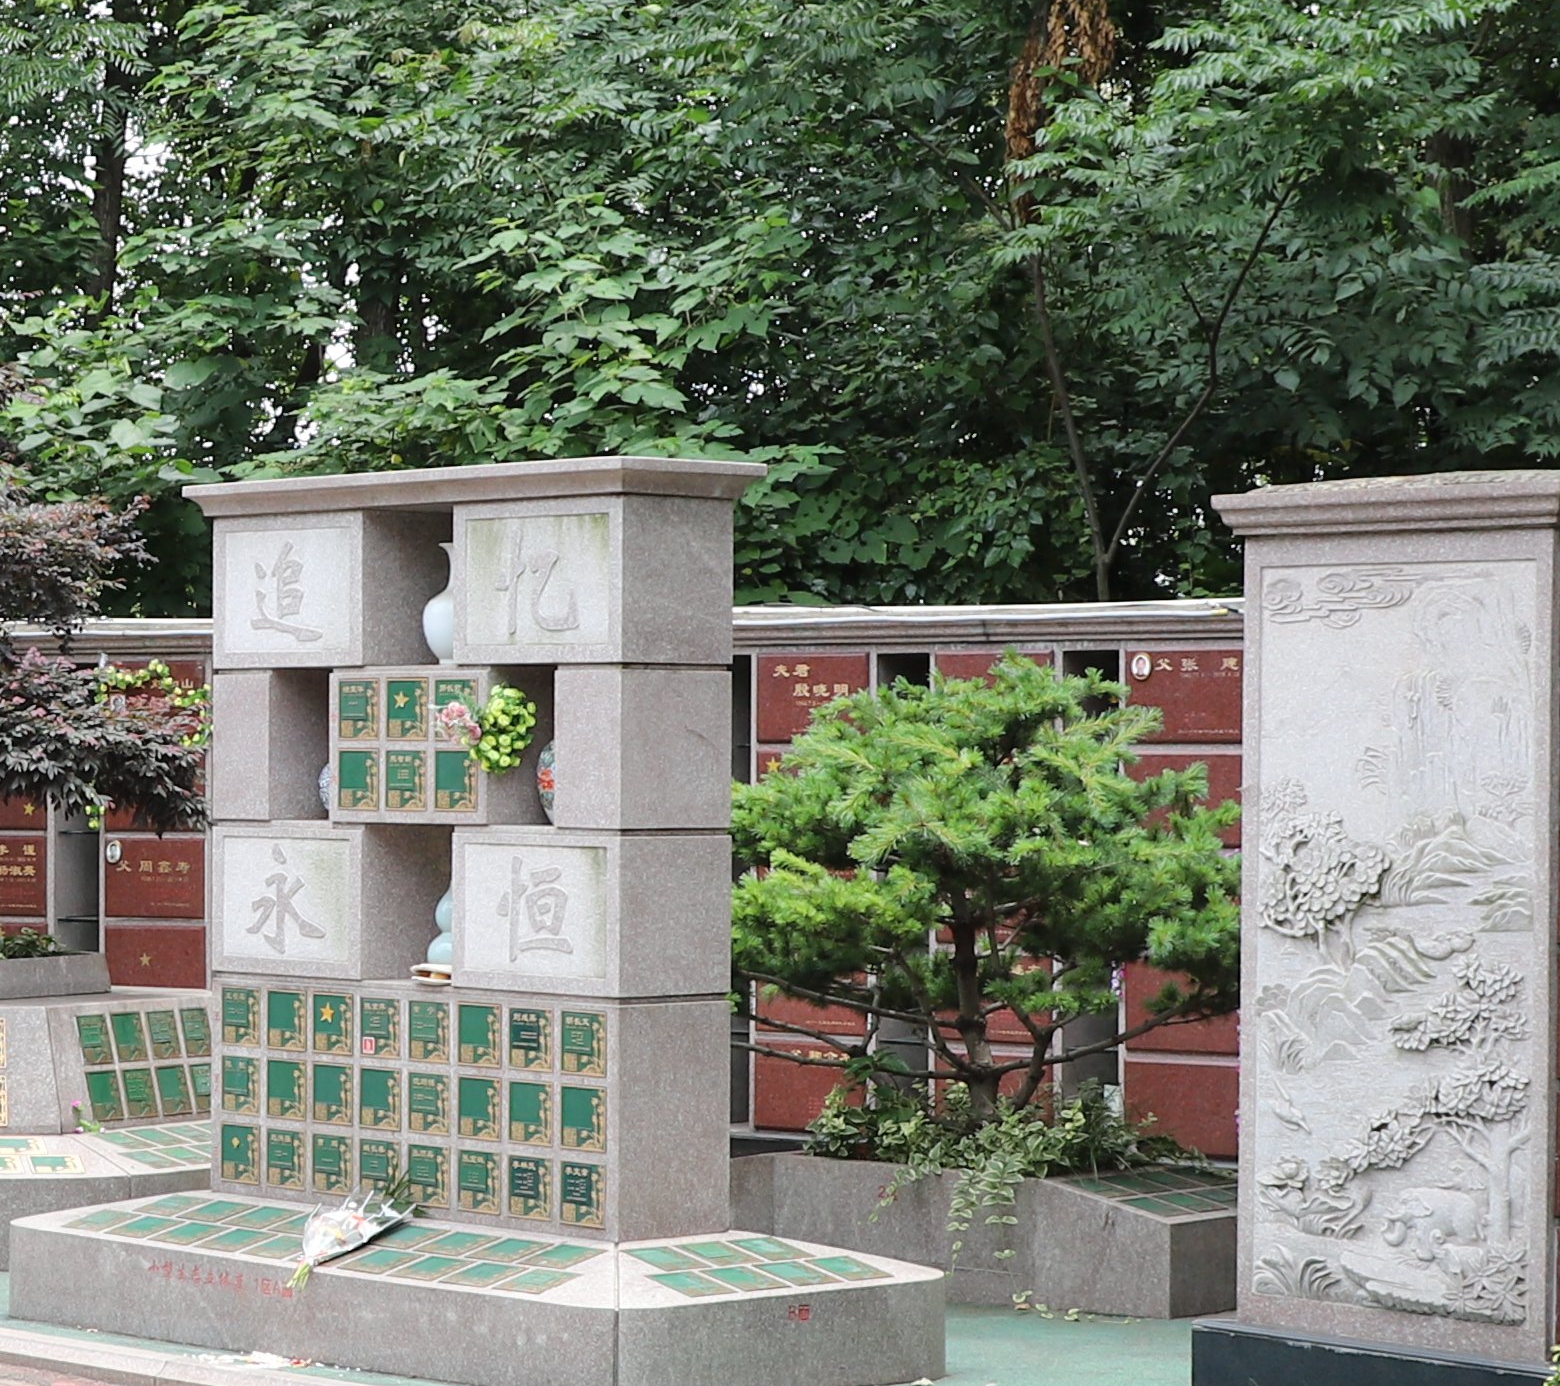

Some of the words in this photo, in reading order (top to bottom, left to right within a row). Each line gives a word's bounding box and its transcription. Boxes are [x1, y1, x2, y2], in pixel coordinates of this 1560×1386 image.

[250, 541, 322, 642] 追
[497, 530, 579, 634] 忆
[246, 844, 326, 954] 永
[496, 856, 574, 961] 恒
